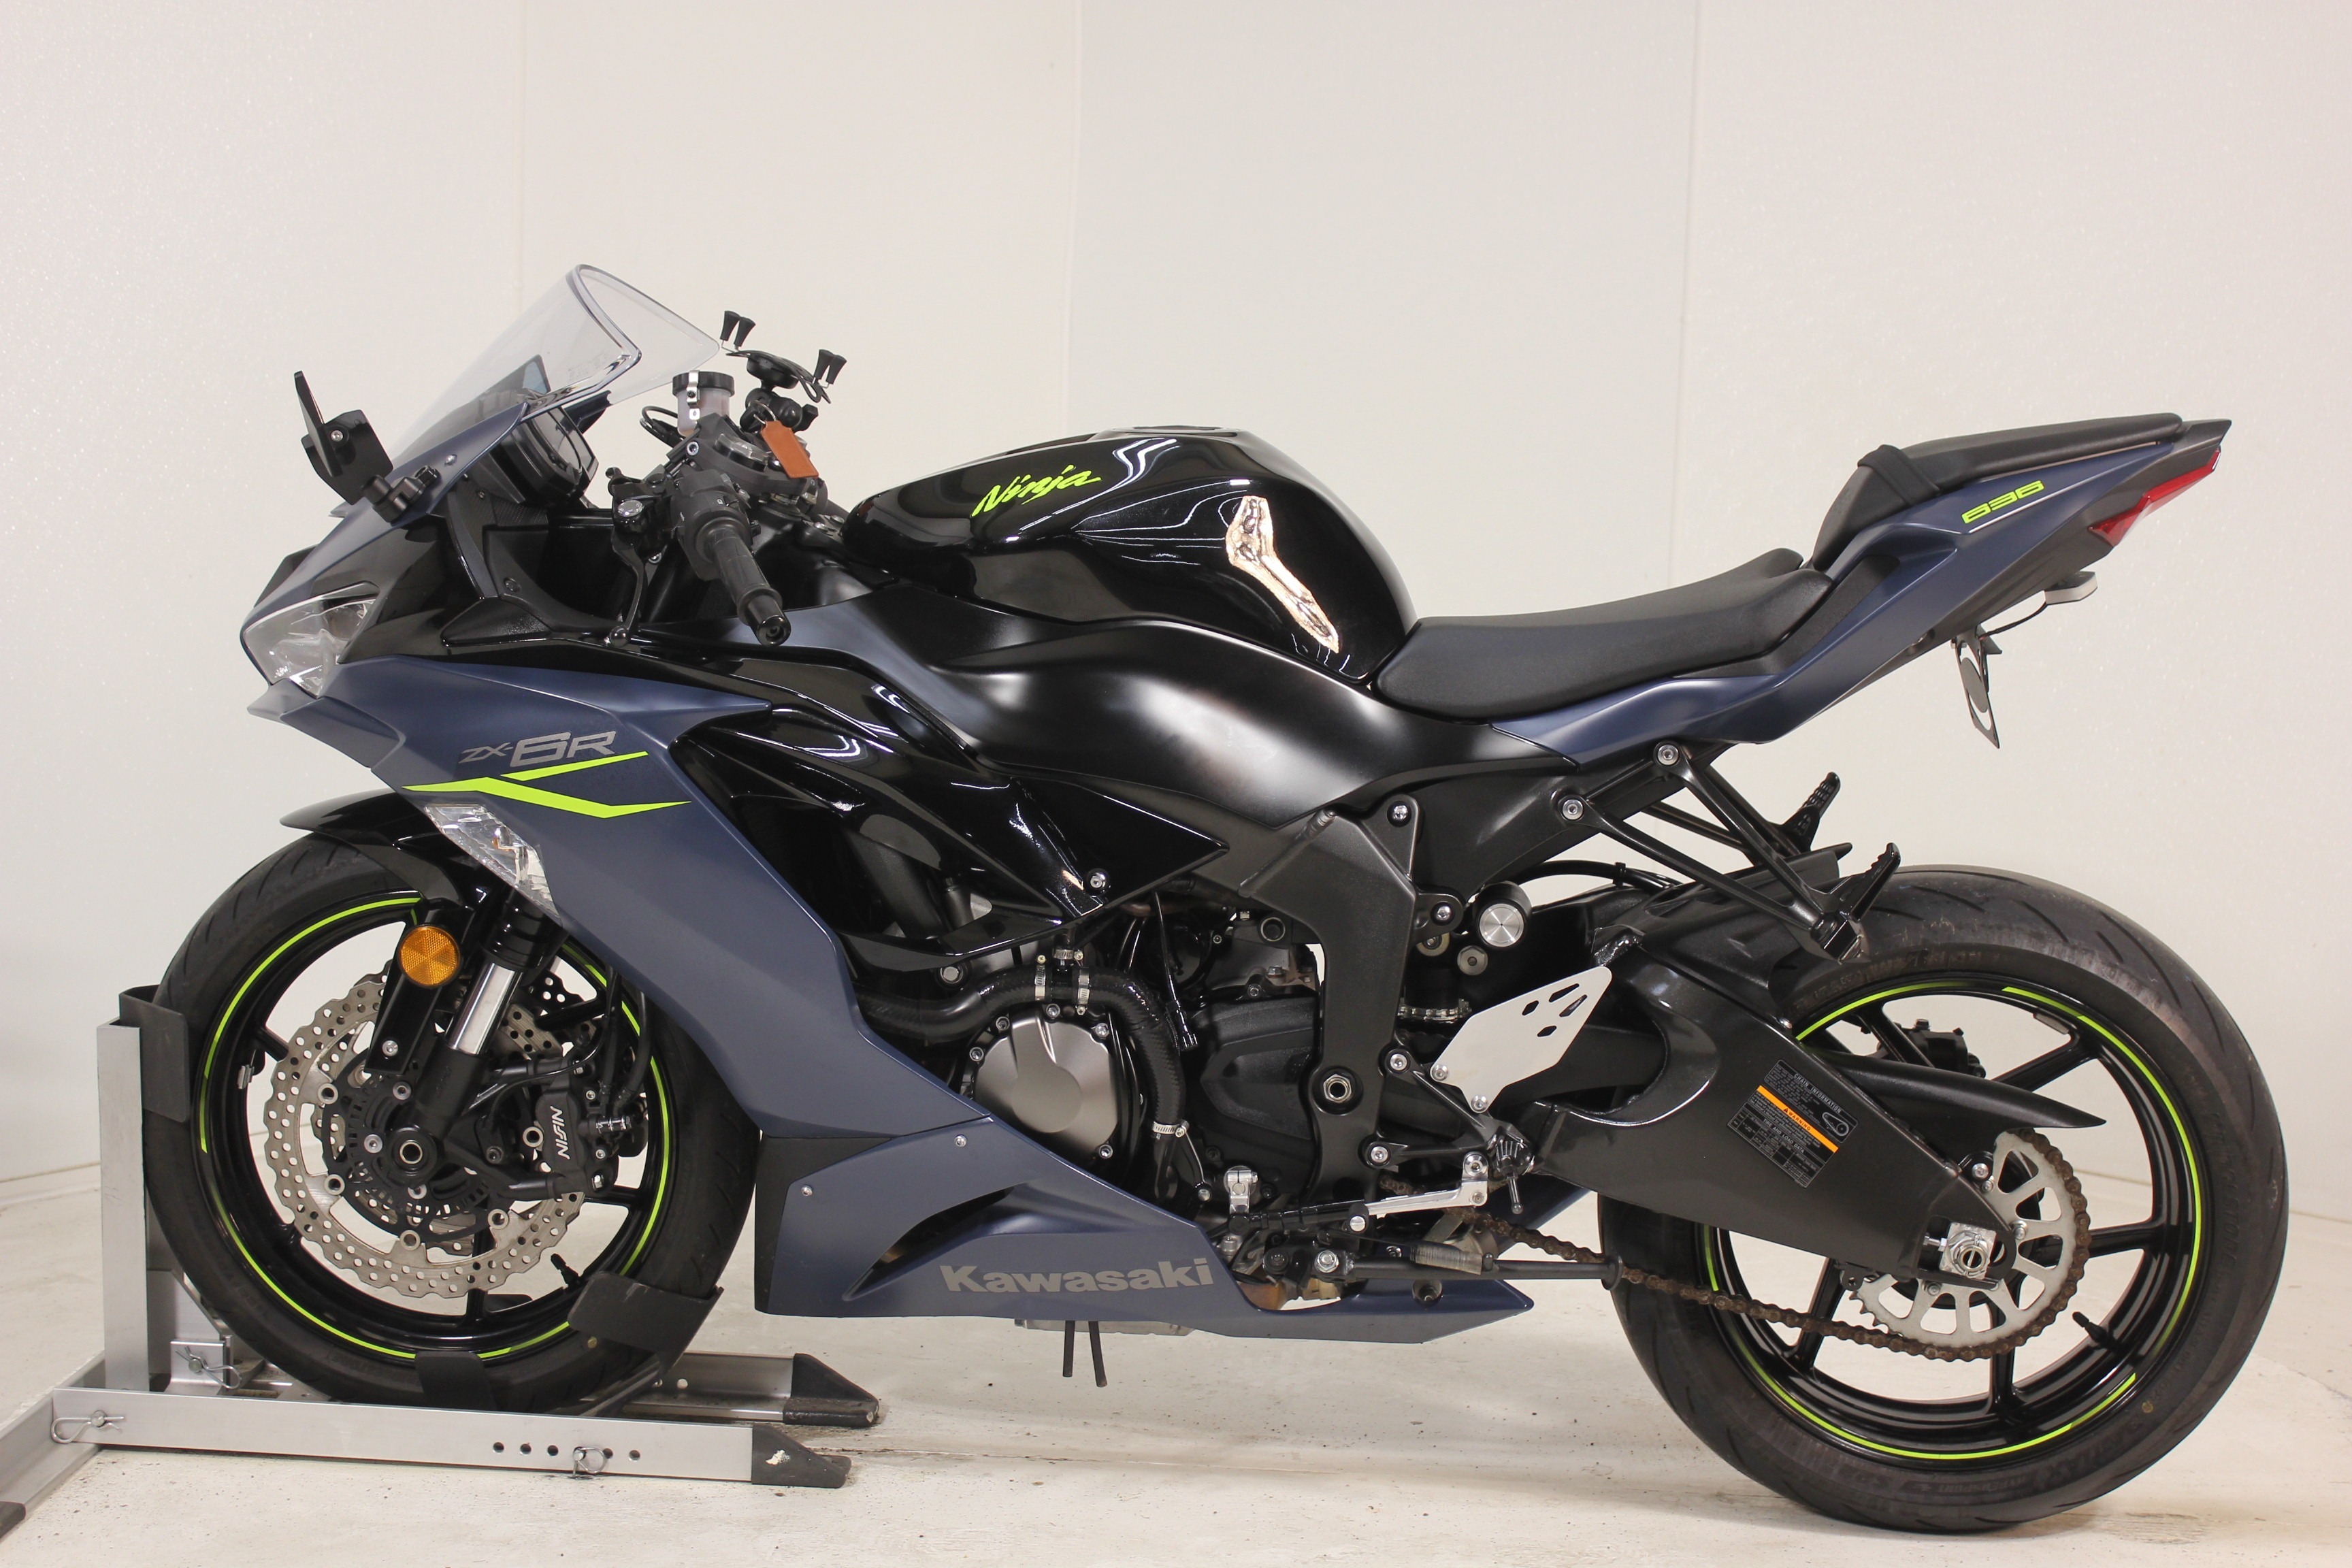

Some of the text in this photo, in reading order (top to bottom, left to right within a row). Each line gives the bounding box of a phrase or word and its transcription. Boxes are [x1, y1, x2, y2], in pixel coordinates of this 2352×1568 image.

[971, 464, 1102, 517] Ninja
[1961, 480, 2044, 524] 636
[459, 731, 616, 767] ZX-6R
[1793, 1073, 1810, 1088] CHAIN
[1810, 1087, 1842, 1113] INFORMATION
[550, 1105, 570, 1160] NISSIN
[1763, 1117, 1772, 1127] TIRE
[1772, 1126, 1782, 1136] AND
[1782, 1134, 1793, 1145] LOAD
[1793, 1143, 1805, 1153] DATA
[1788, 1111, 1811, 1131] WARNING
[939, 1258, 1213, 1292] Kawasaki
